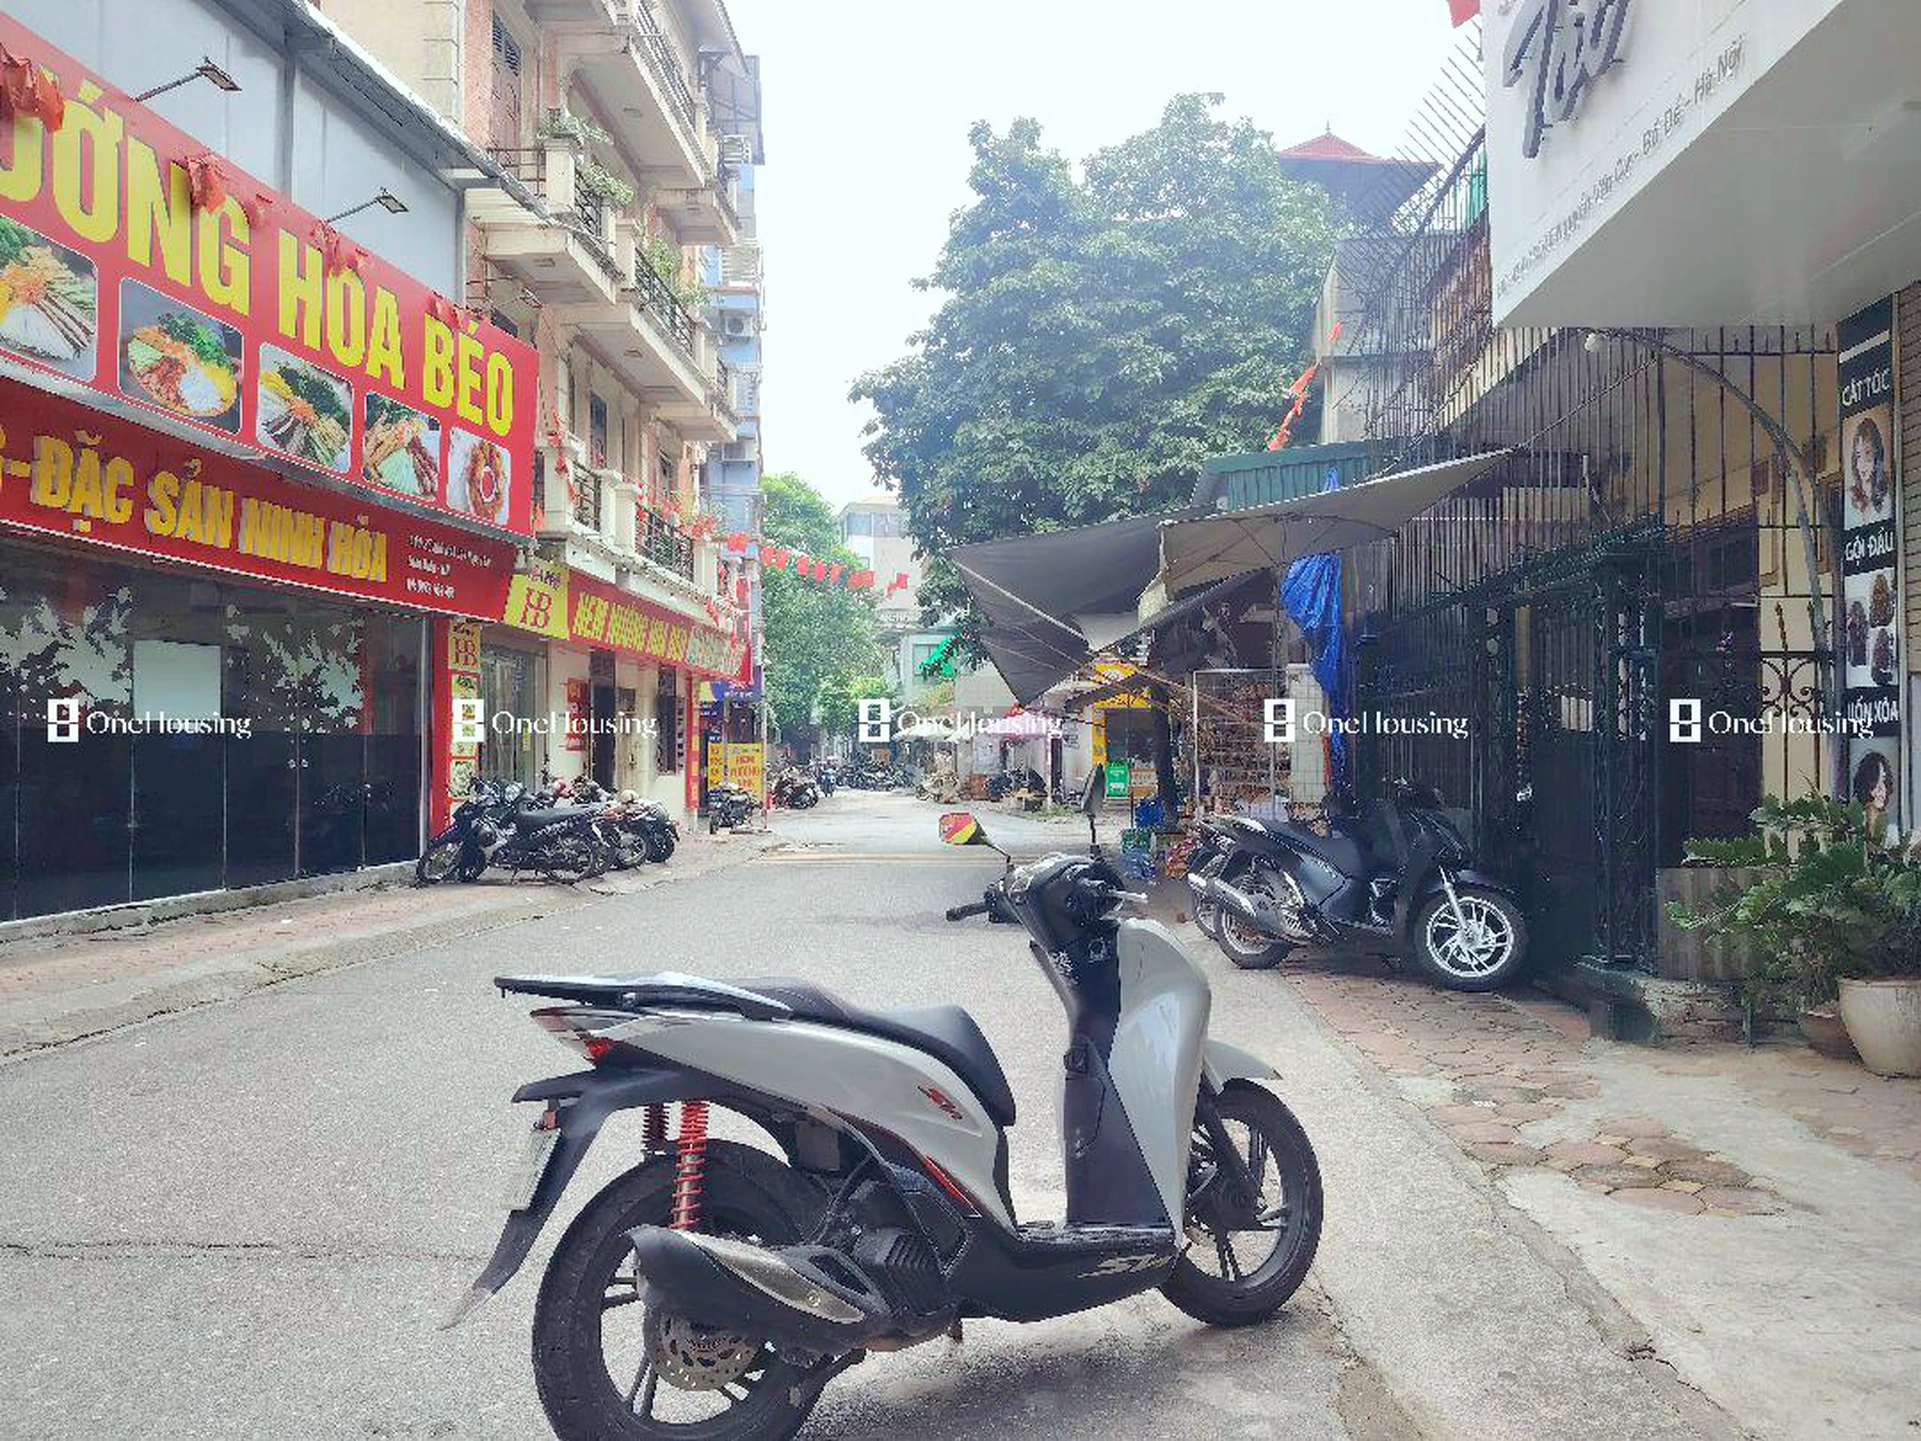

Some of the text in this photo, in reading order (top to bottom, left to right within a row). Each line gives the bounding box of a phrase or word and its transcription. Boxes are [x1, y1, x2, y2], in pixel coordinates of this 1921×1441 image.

[422, 312, 513, 437] BÉO
[1863, 367, 1890, 398] TÓC
[144, 457, 234, 549] SẢN
[238, 497, 325, 570] NINH
